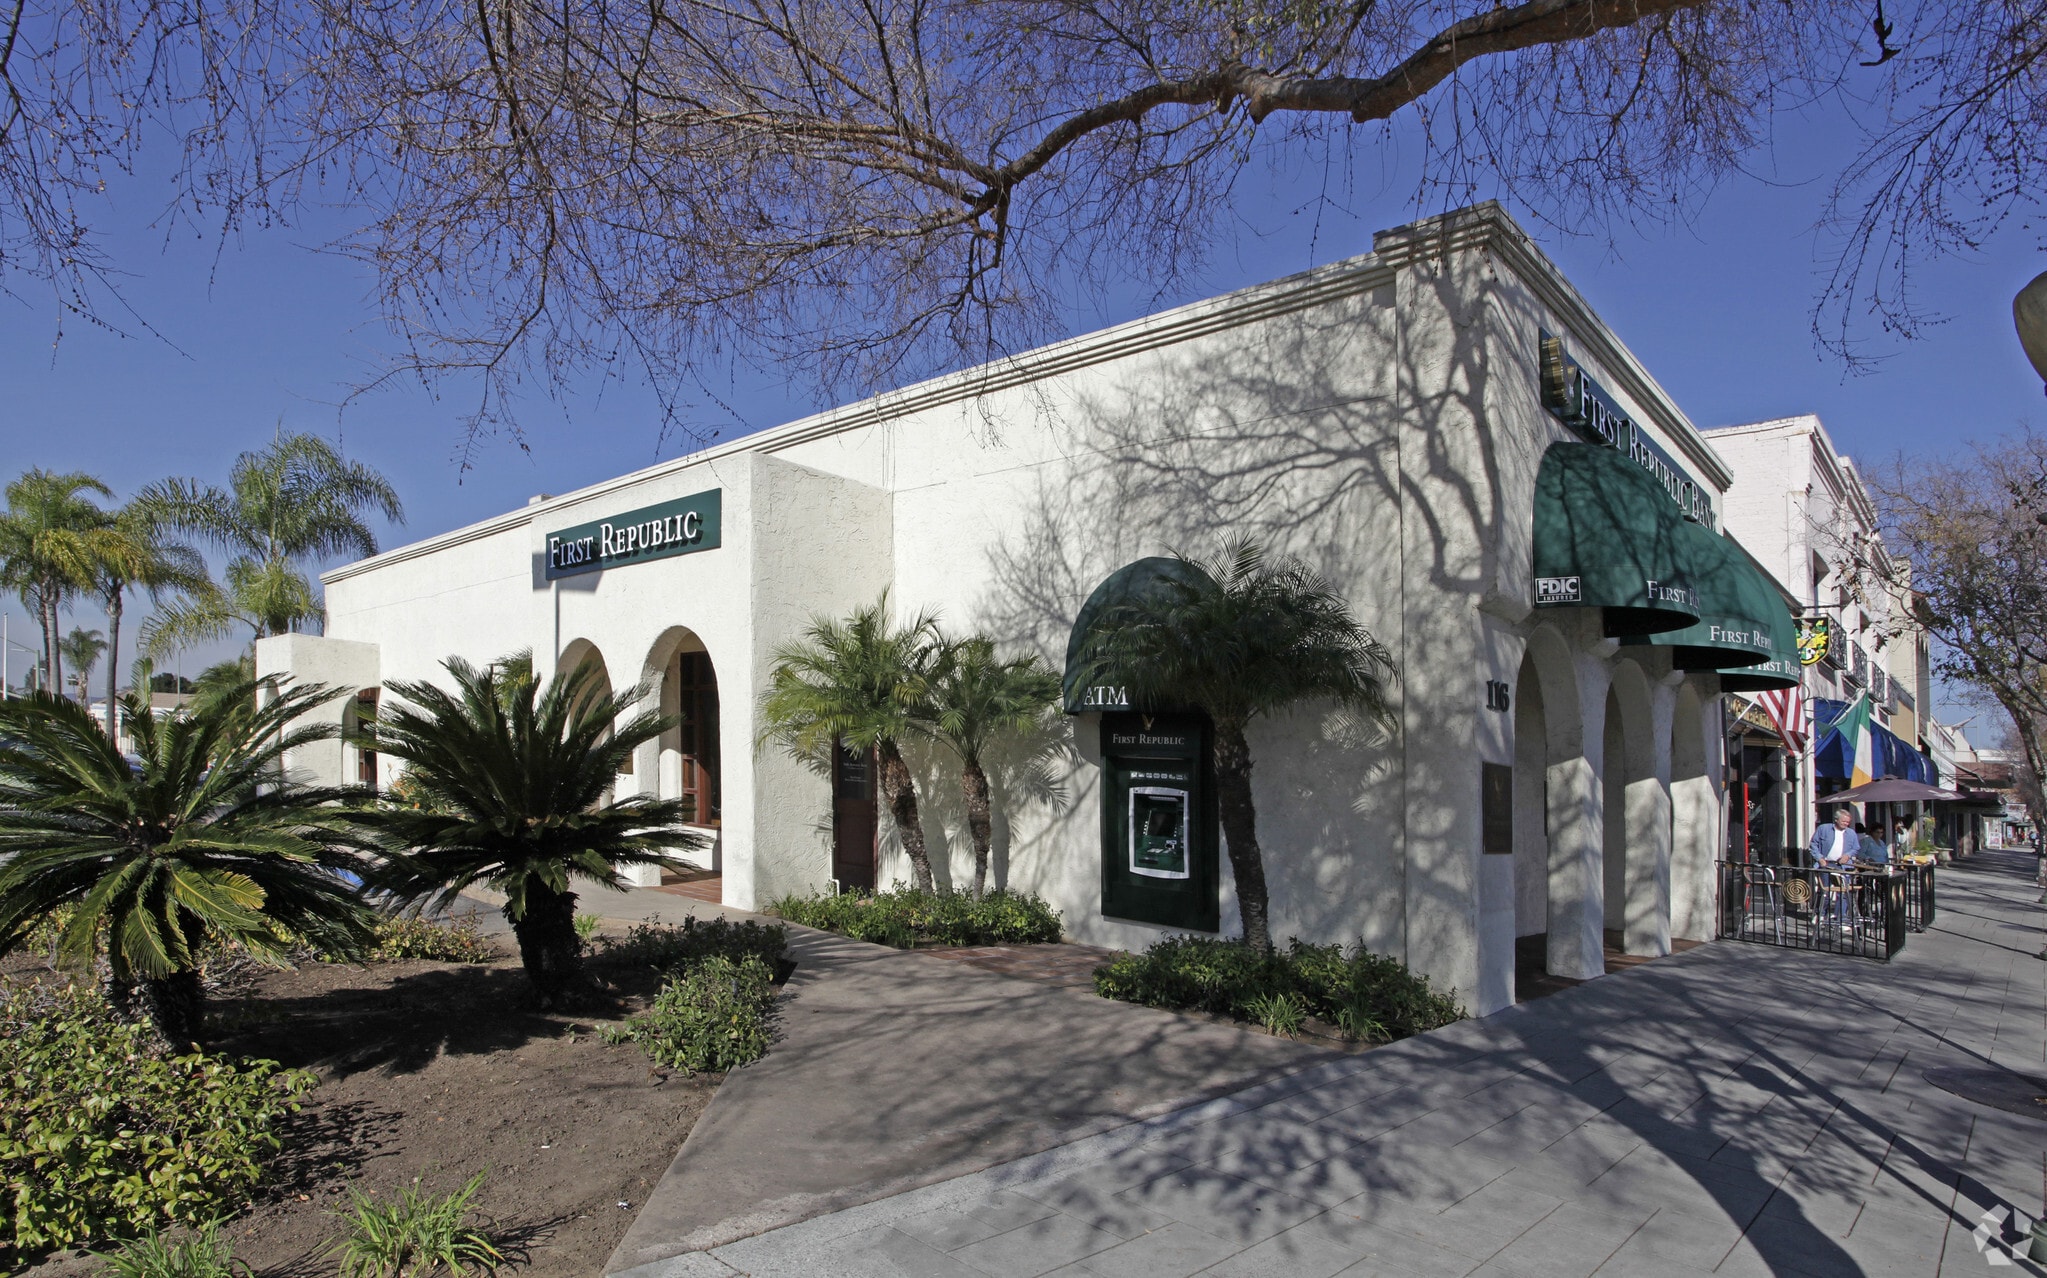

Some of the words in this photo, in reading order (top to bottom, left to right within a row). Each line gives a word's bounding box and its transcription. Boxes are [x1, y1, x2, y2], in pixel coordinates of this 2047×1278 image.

[1579, 369, 1622, 450] FIRST
[1692, 482, 1717, 533] BANK
[549, 536, 593, 568] FIRST
[600, 511, 697, 557] REPUBLIC
[1538, 579, 1577, 594] FDIC
[1646, 580, 1686, 604] FIRST
[1709, 626, 1749, 644] FIRST
[1747, 661, 1781, 672] IRST
[1084, 686, 1129, 705] ATM
[1486, 679, 1510, 713] 116
[1112, 733, 1136, 744] FIRST
[1139, 733, 1185, 745] REPUBLIC
